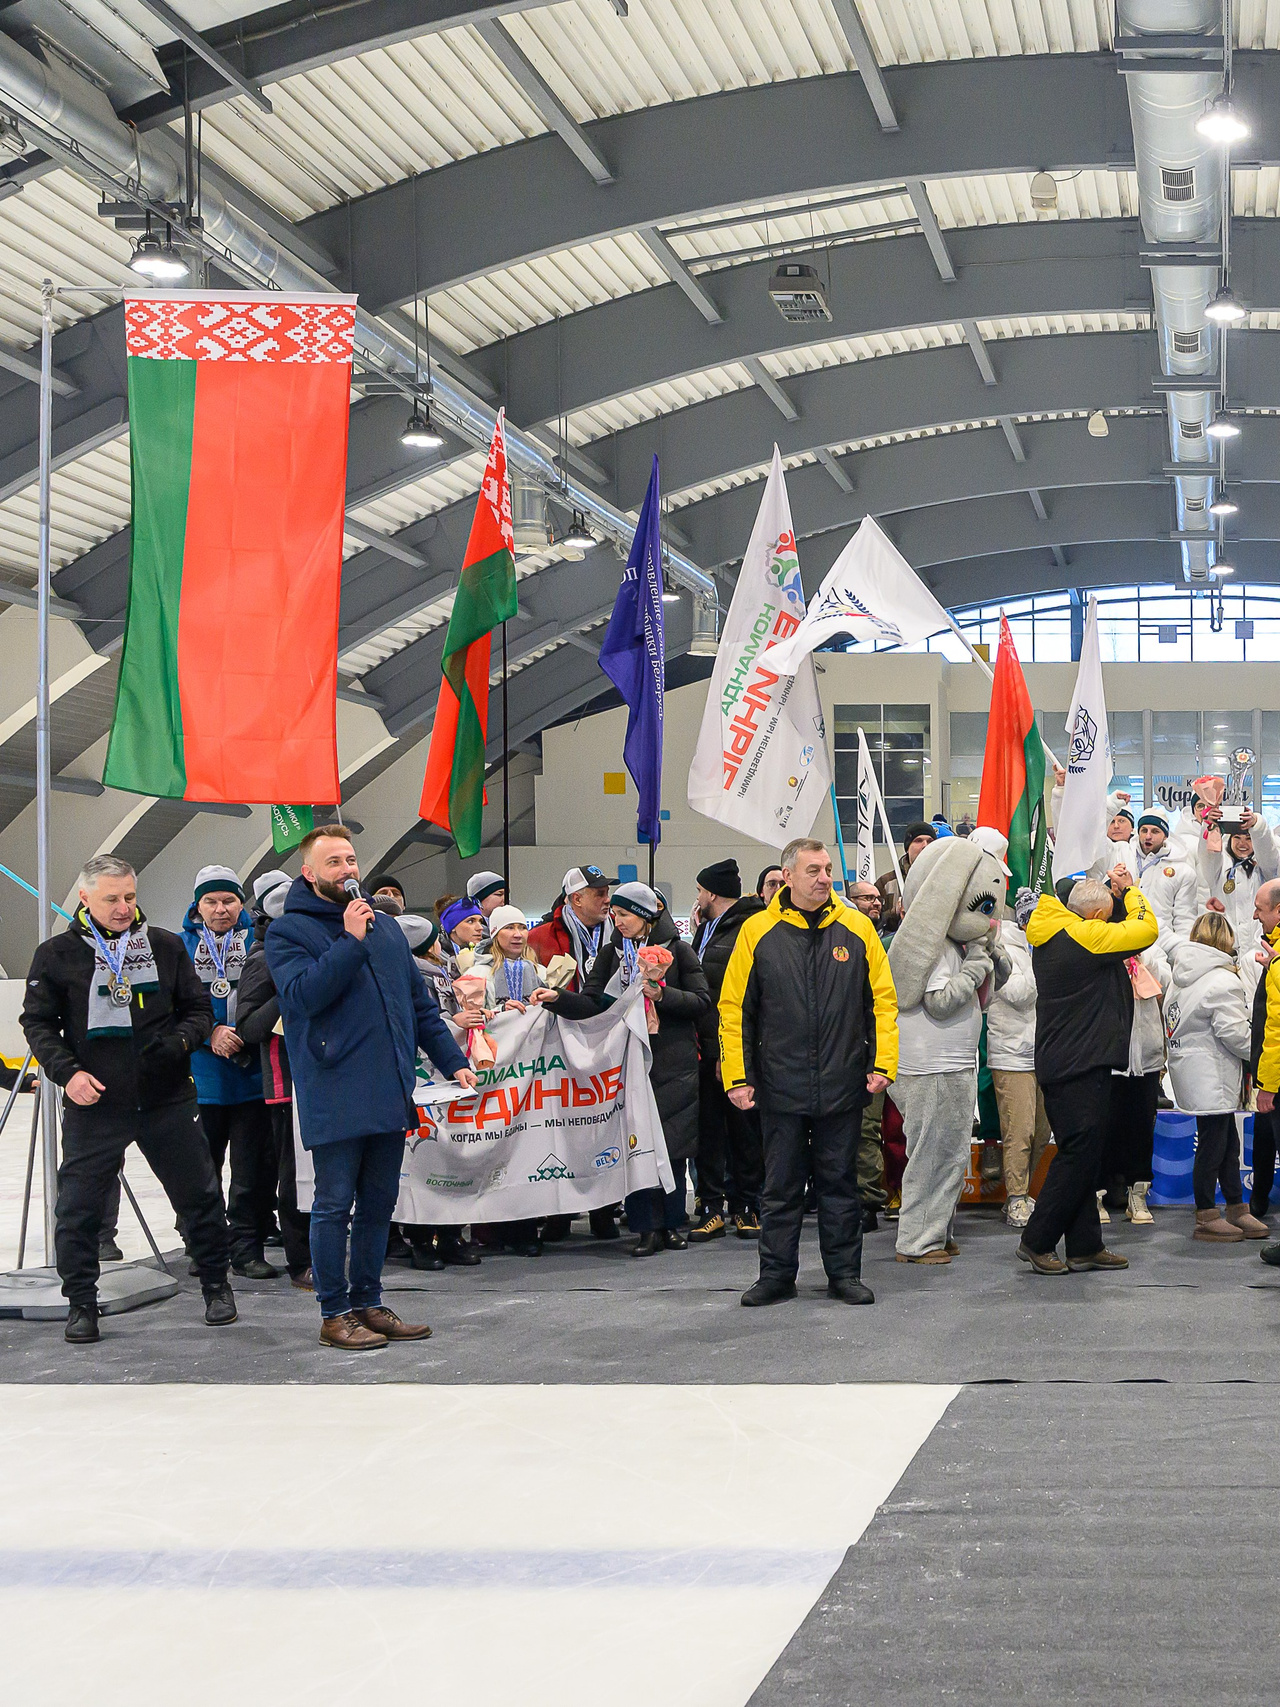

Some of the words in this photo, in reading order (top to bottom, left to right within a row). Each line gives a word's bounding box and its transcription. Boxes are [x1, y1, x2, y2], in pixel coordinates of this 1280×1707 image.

[272, 804, 290, 837] ларусь
[283, 804, 301, 831] лики»
[475, 1054, 567, 1086] ОМАНДА
[447, 1066, 625, 1130] ЕДИНЫЕ
[450, 1132, 482, 1144] КОГДА
[485, 1130, 503, 1141] МЫ
[504, 1122, 528, 1138] ЕДИНЫ
[545, 1119, 566, 1129] МЫ
